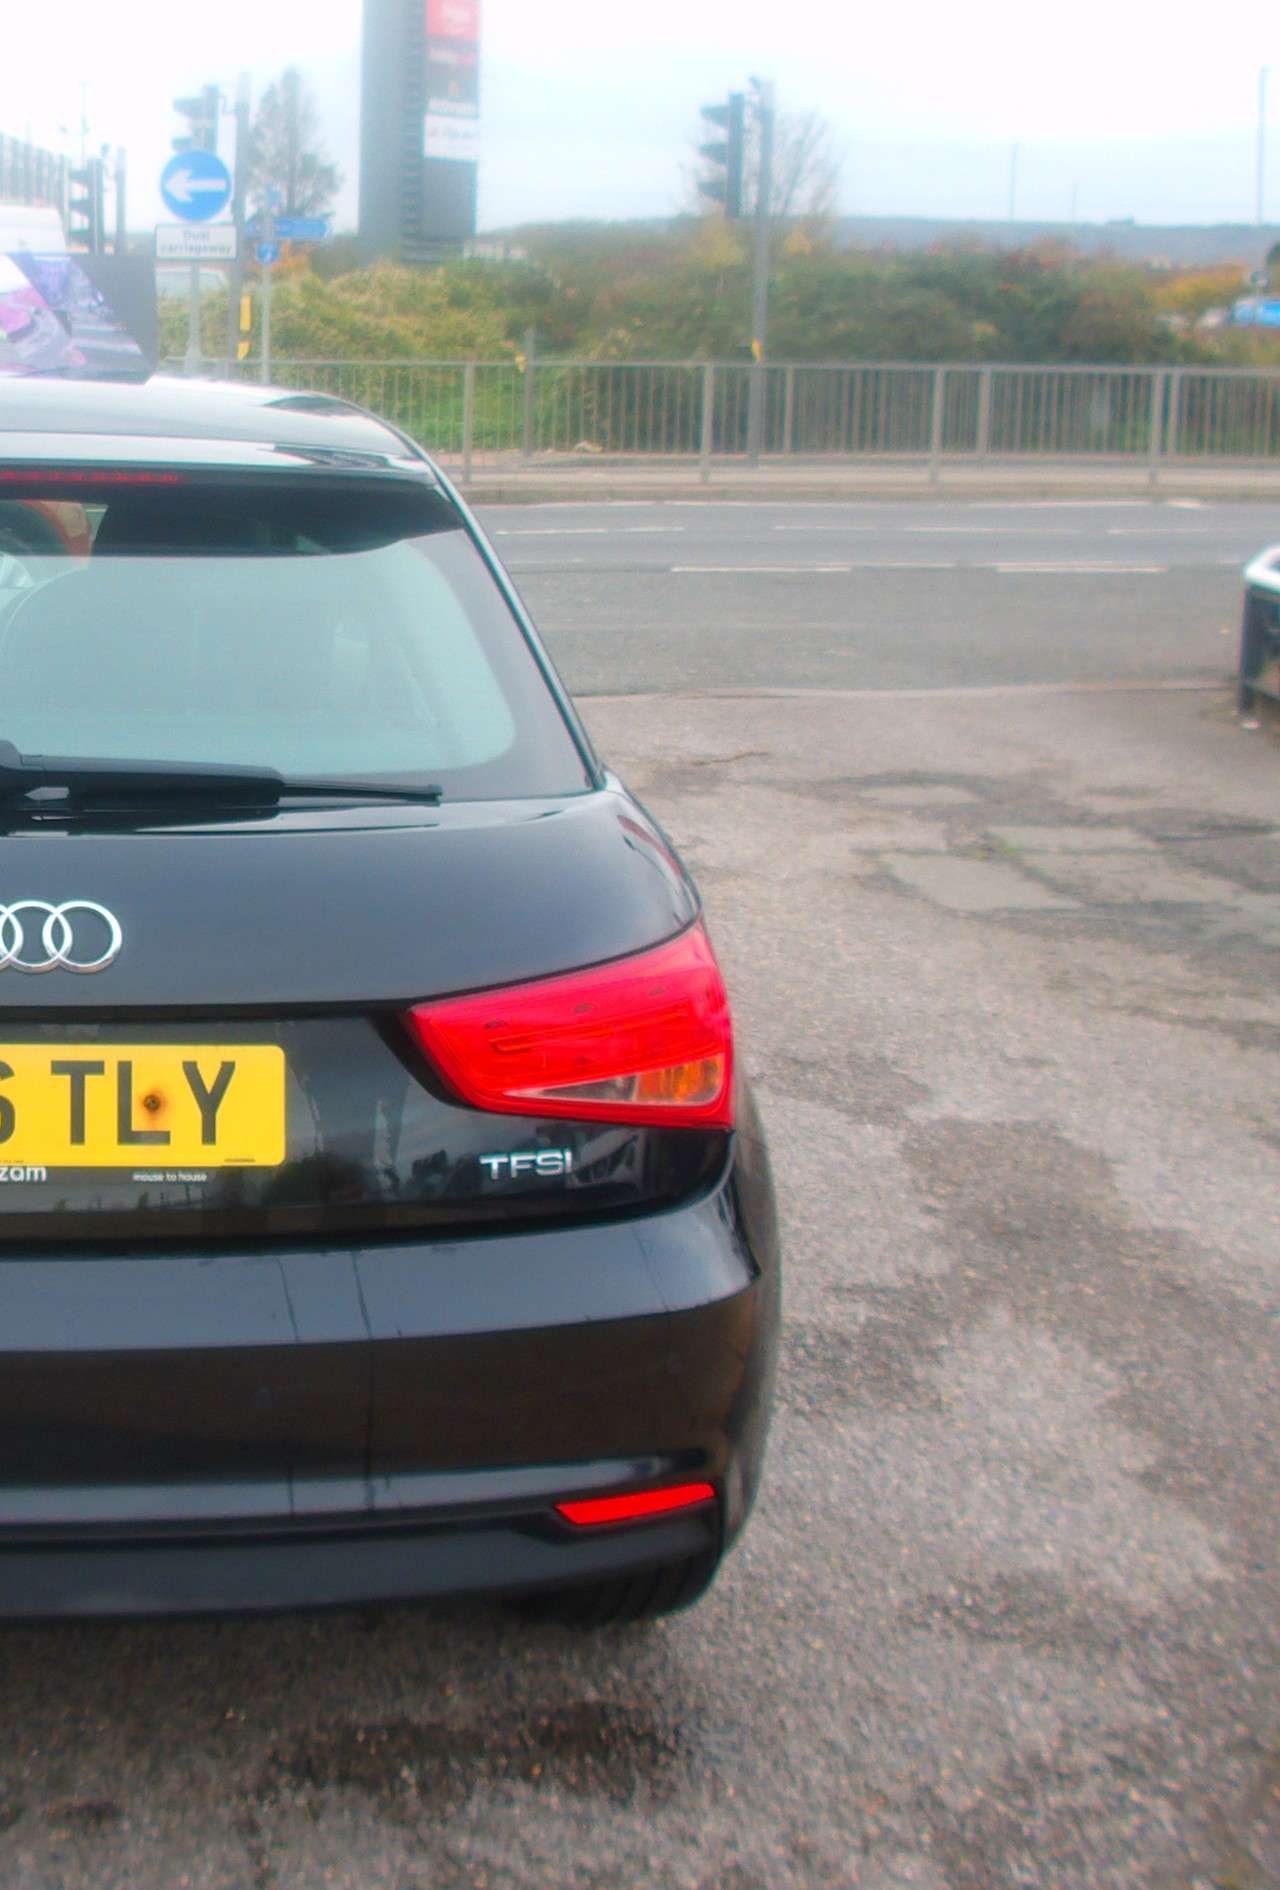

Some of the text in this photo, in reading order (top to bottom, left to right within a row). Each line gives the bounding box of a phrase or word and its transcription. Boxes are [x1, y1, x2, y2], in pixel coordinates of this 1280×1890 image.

[51, 1060, 236, 1146] TLY
[132, 1170, 208, 1182] mouse to house
[480, 1148, 573, 1180] TFSI
